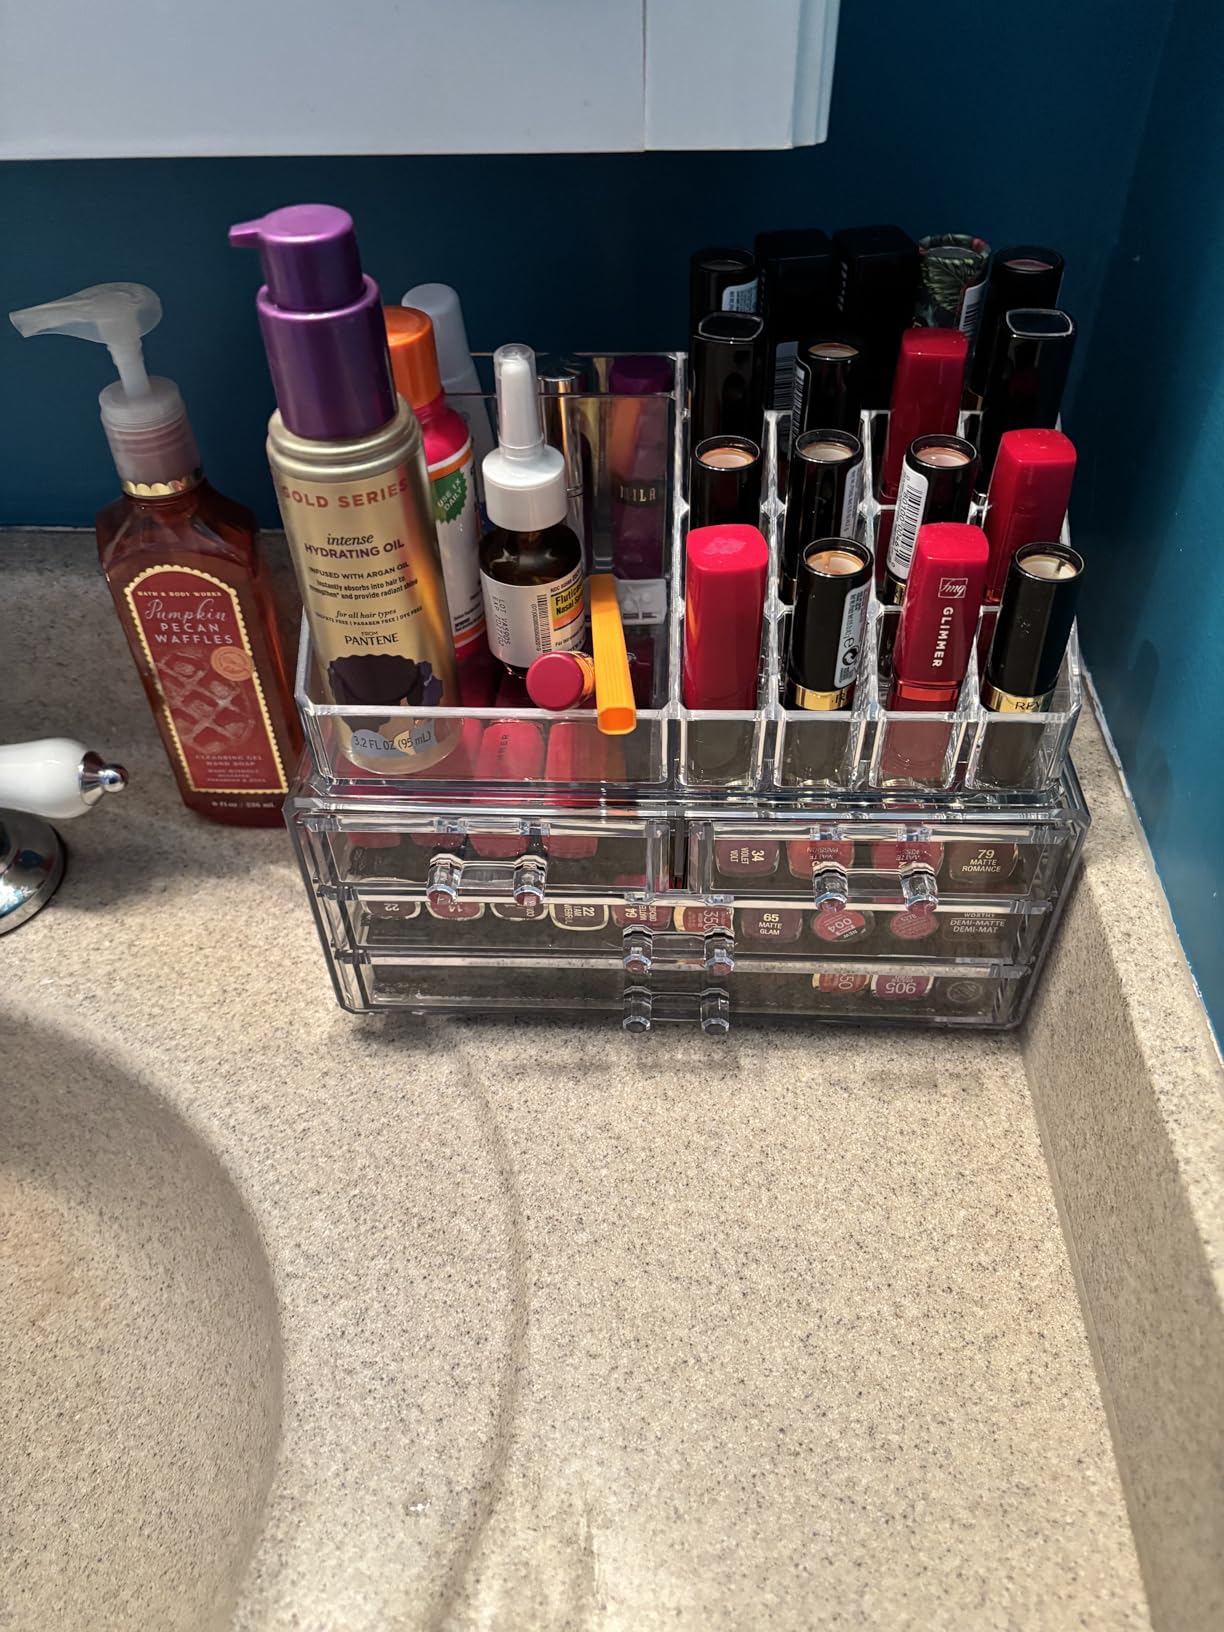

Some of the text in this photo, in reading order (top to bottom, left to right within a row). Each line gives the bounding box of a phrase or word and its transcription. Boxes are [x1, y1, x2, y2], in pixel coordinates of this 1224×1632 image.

[282, 478, 408, 508] GOLD SERIES
[444, 488, 463, 512] DAILY
[327, 533, 374, 546] intense
[304, 538, 405, 559] HYDRATING OIL
[308, 562, 409, 580] INFUSED WITH ARGAN OIL
[344, 583, 370, 591] absorbs
[371, 582, 384, 590] into
[385, 578, 398, 587] hair
[354, 592, 380, 600] provide
[380, 586, 403, 597] radiant
[144, 598, 226, 624] Pumpkin
[348, 610, 359, 619] all
[360, 610, 376, 619] hair
[378, 609, 397, 619] types
[160, 623, 219, 632] PECAN
[154, 634, 233, 644] WAFFLES
[344, 632, 399, 646] PANTENE
[932, 606, 954, 668] GLIMMER
[353, 730, 432, 751] 3.2 FL OZ (95 mL)
[730, 850, 739, 863] VOLT
[740, 847, 750, 865] VIOLET
[751, 849, 765, 862] 34
[977, 849, 995, 859] 79
[961, 865, 1001, 873] ROMANCE
[582, 906, 595, 917] 22
[625, 907, 638, 918] 64
[763, 913, 779, 922] 65
[758, 922, 783, 930] MATTE
[827, 917, 852, 933] 004
[838, 974, 854, 990] 50
[885, 982, 917, 994] 905
